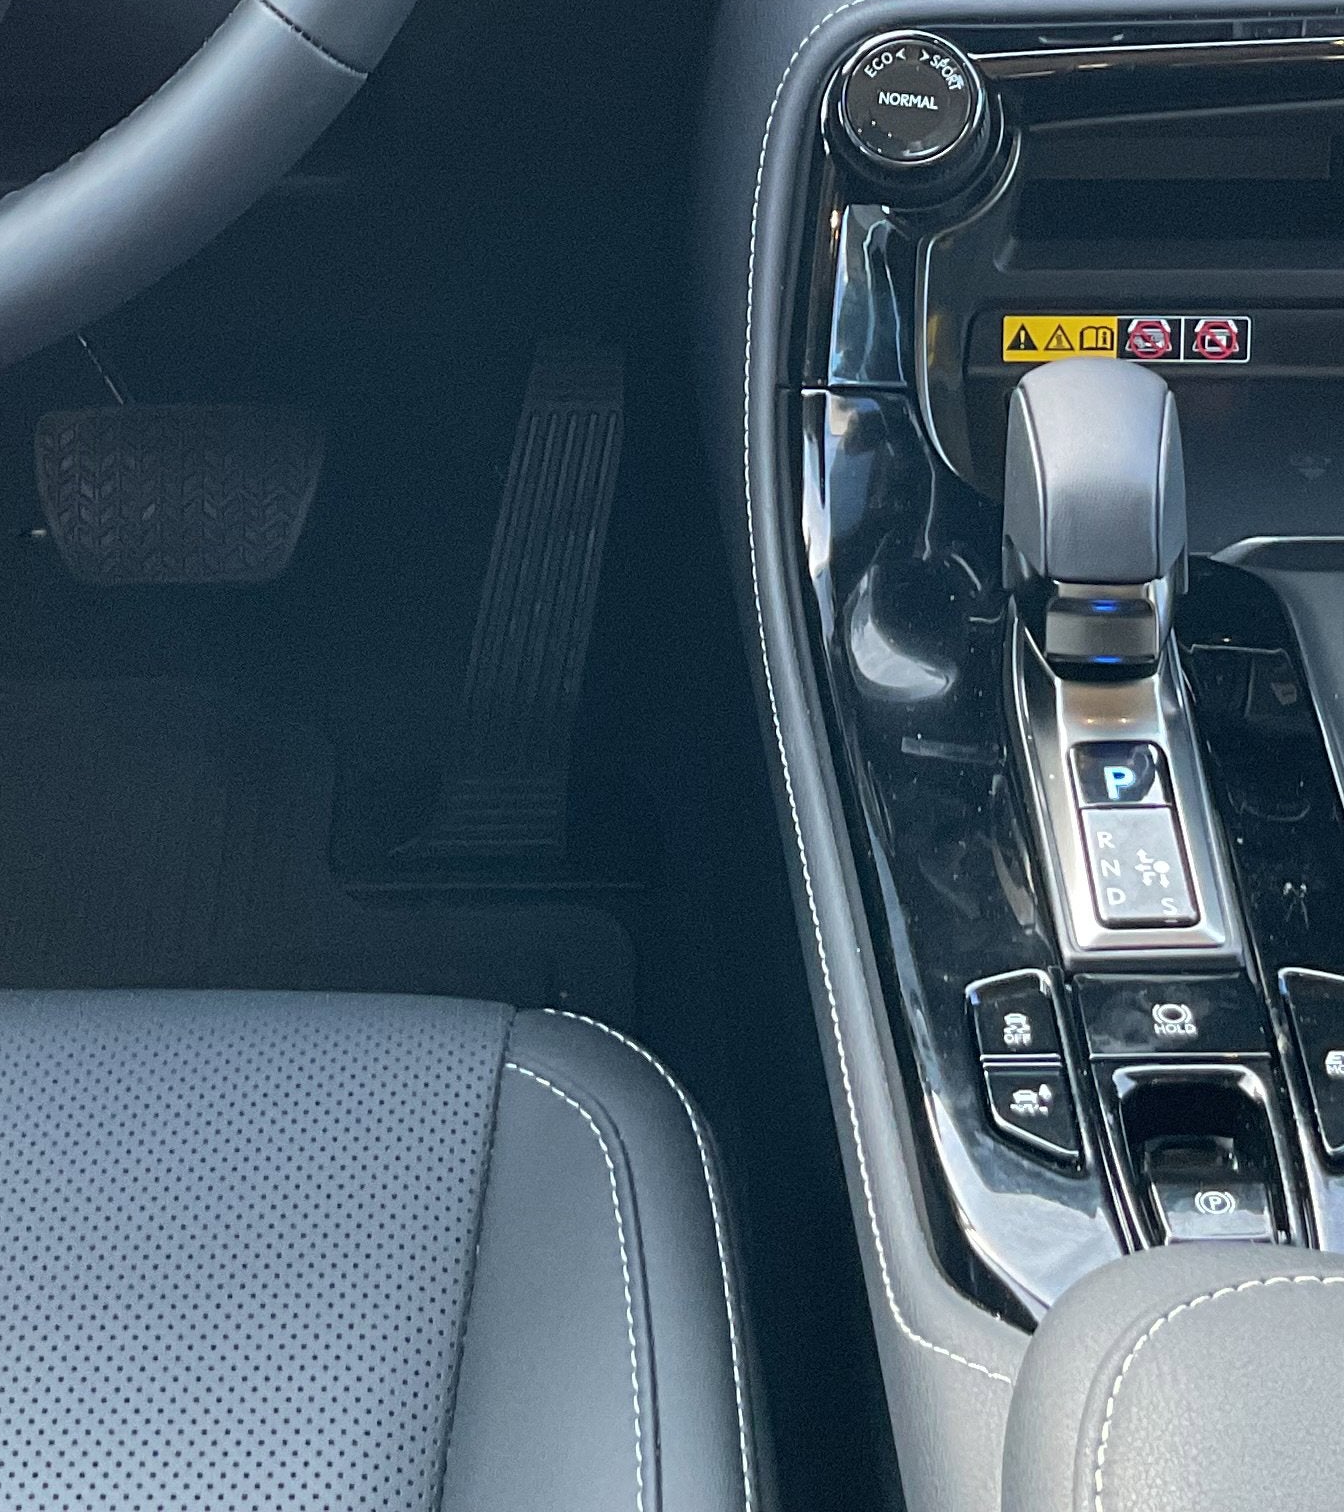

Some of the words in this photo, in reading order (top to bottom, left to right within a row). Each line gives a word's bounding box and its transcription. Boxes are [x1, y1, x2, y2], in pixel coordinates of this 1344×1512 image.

[864, 52, 893, 79] ECO
[930, 54, 965, 90] SPORT
[878, 90, 939, 111] NORMAL
[1103, 765, 1136, 800] P
[1096, 831, 1116, 849] R
[1100, 859, 1121, 877] N
[1106, 887, 1127, 906] D
[1160, 897, 1178, 916] S
[1154, 1022, 1197, 1037] HOLD
[1003, 1032, 1032, 1047] OFF
